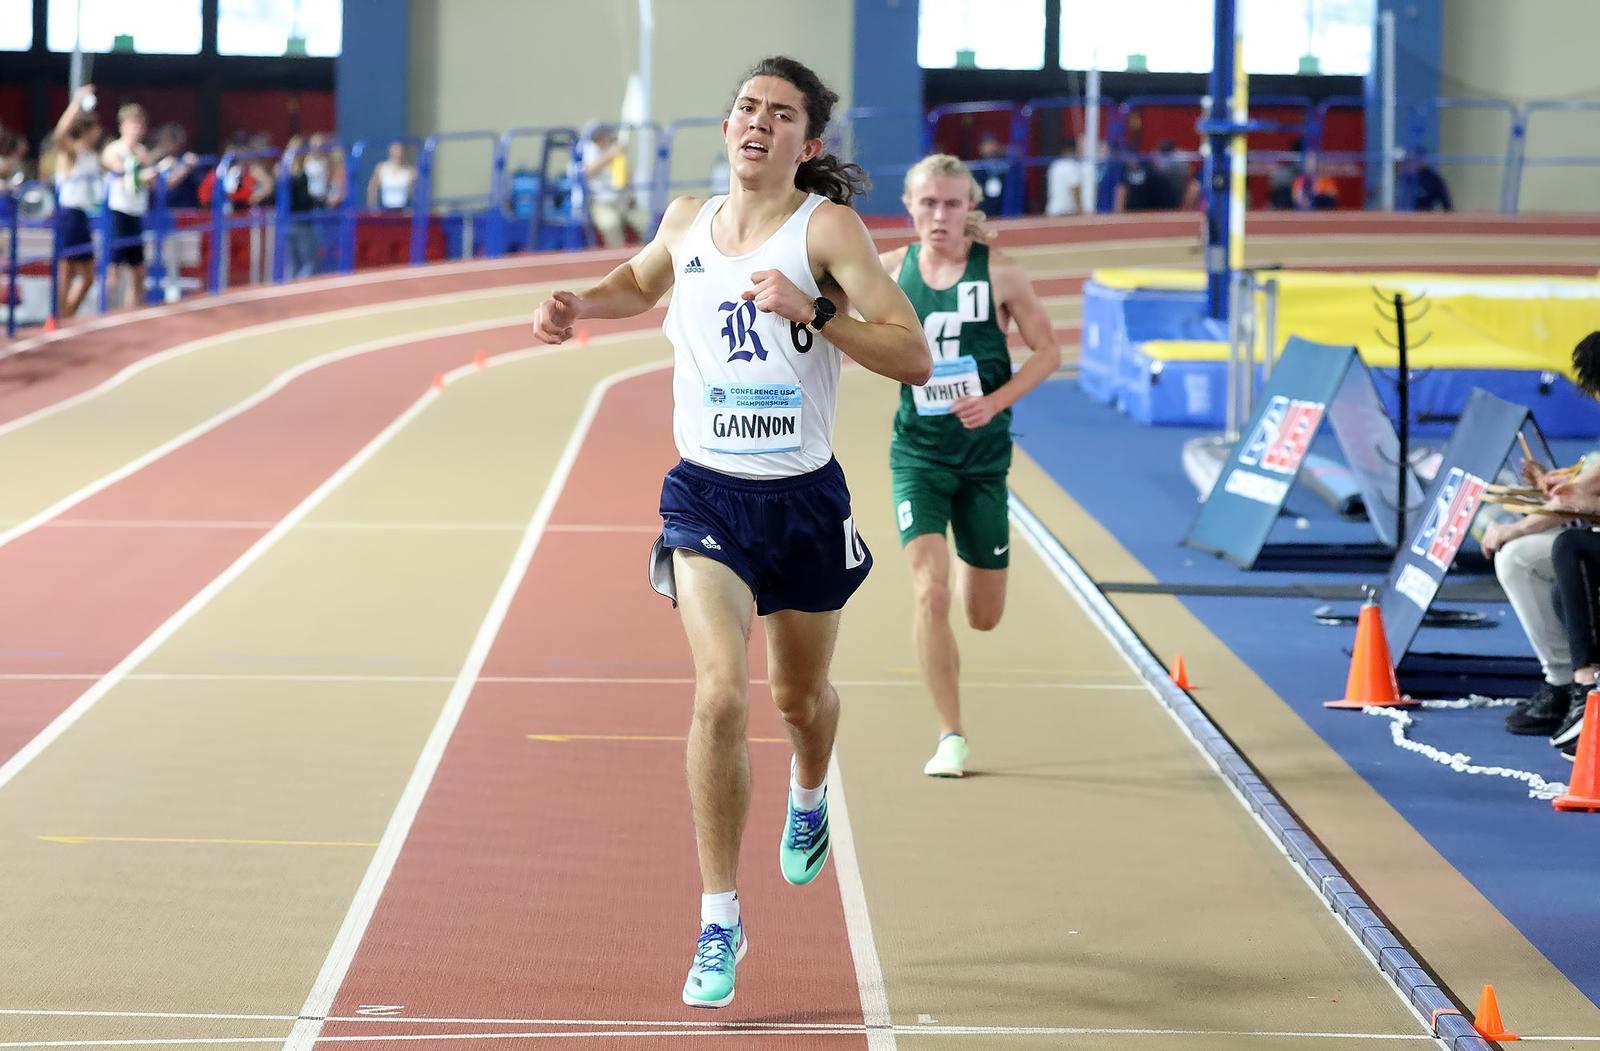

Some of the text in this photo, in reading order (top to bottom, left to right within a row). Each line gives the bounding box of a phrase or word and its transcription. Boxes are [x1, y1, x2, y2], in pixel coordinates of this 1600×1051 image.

[967, 285, 979, 319] 1
[790, 319, 813, 354] 6
[730, 387, 779, 396] CONFERENCE
[924, 380, 969, 401] WHITE
[713, 413, 795, 439] GANNON
